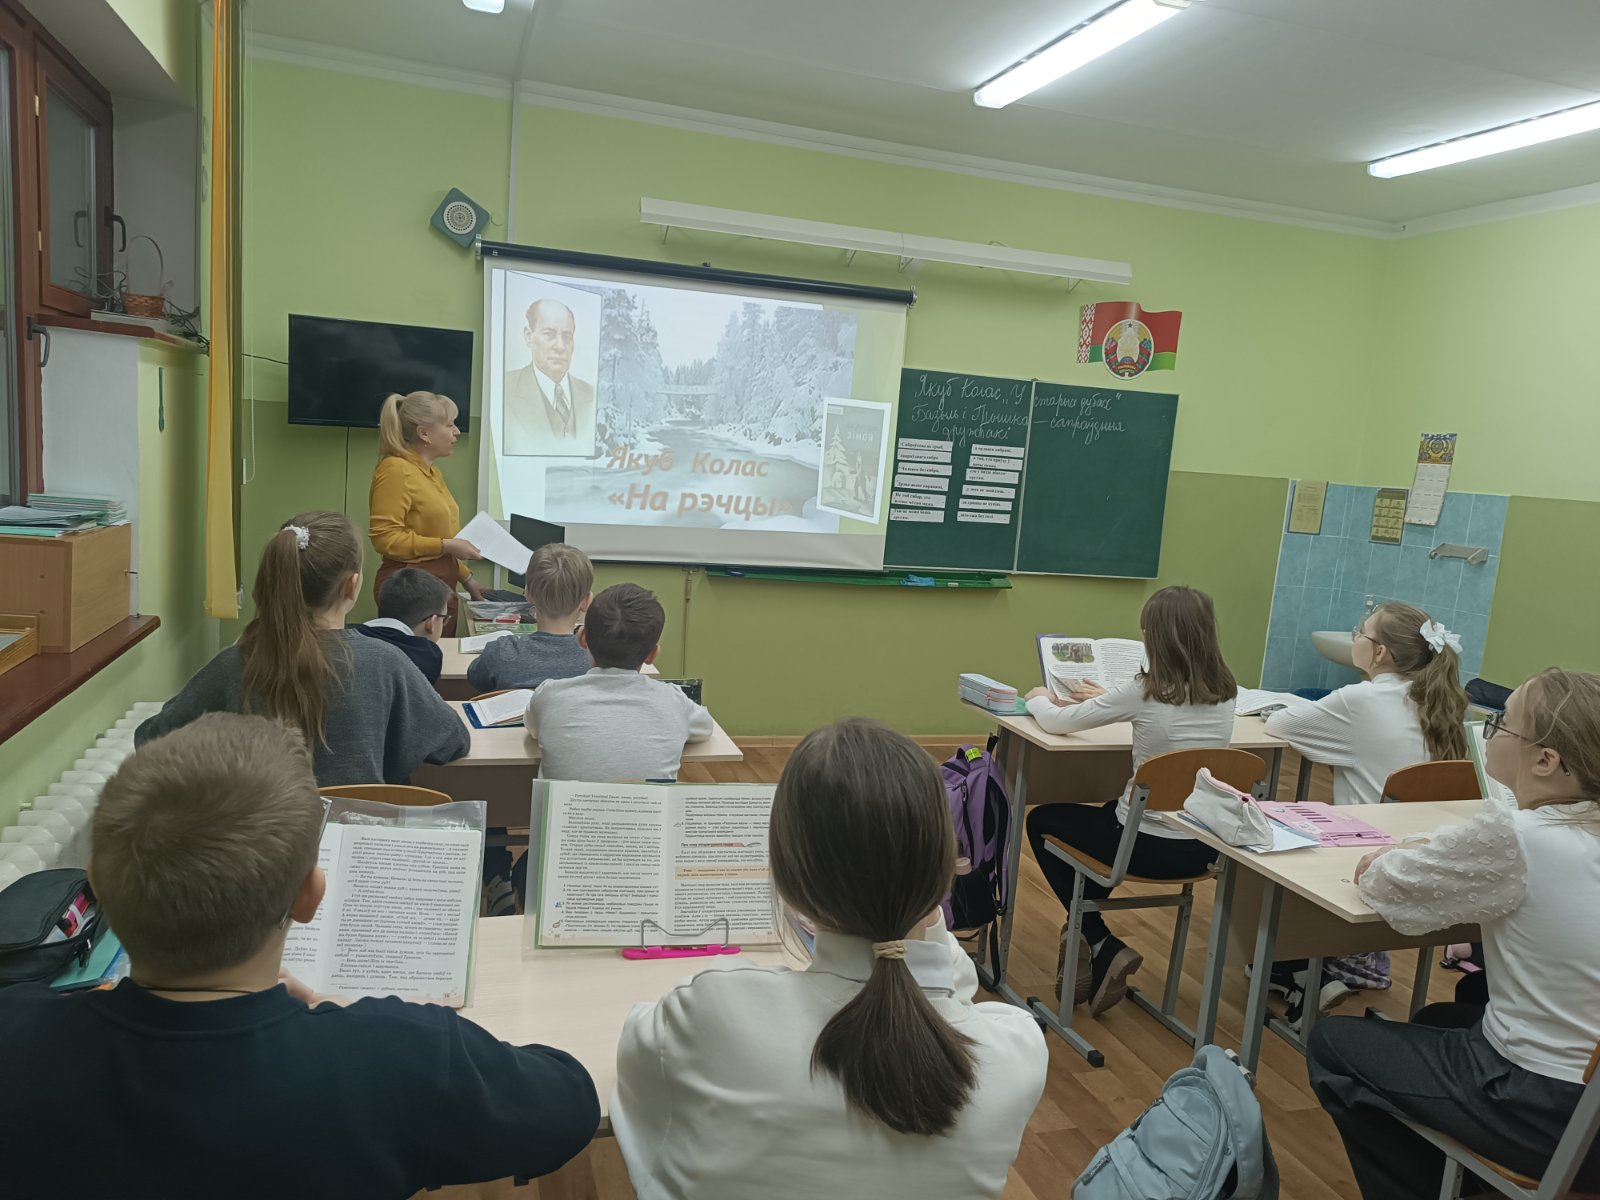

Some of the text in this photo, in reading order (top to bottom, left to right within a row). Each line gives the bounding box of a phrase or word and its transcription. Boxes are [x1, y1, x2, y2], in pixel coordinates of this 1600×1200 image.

[606, 446, 770, 478] Якуб Колас
[608, 482, 793, 521] «На рэчцы»
